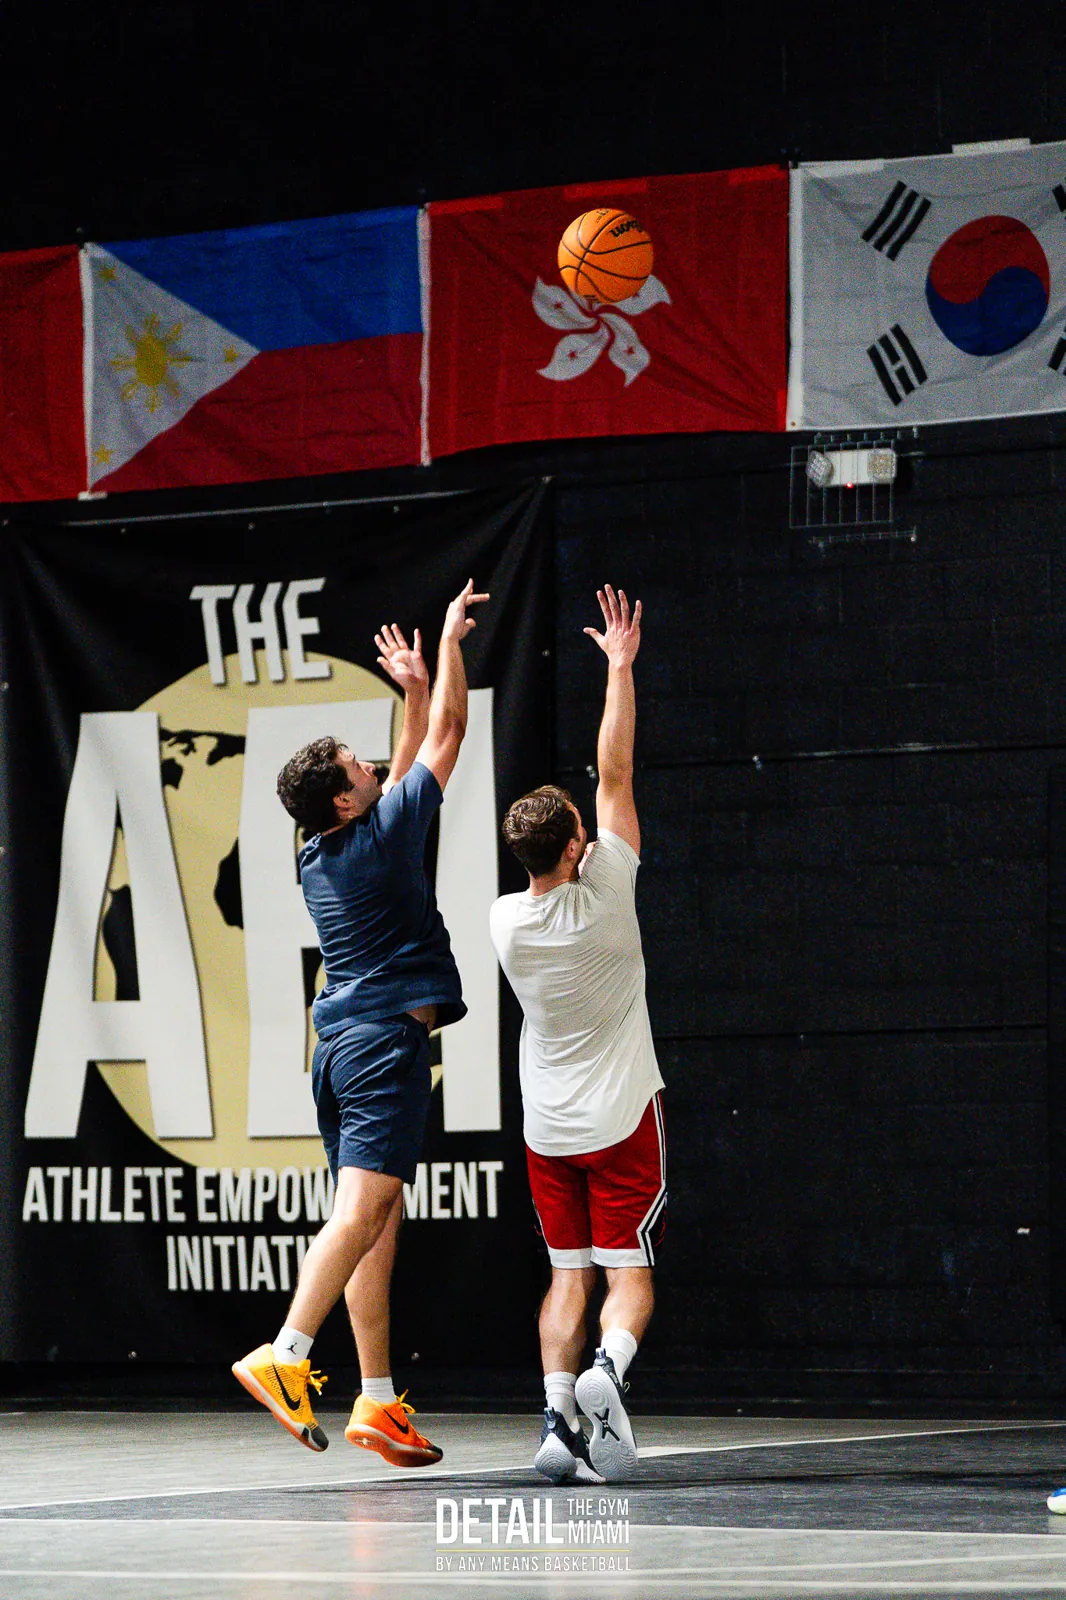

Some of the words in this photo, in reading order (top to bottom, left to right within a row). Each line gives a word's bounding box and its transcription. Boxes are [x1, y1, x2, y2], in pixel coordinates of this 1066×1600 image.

[189, 577, 332, 686] THE
[24, 687, 502, 1139] AEI
[22, 1166, 186, 1222] ATHLETE
[197, 1161, 504, 1222] EMPOWMENT
[166, 1235, 316, 1291] INITIATI
